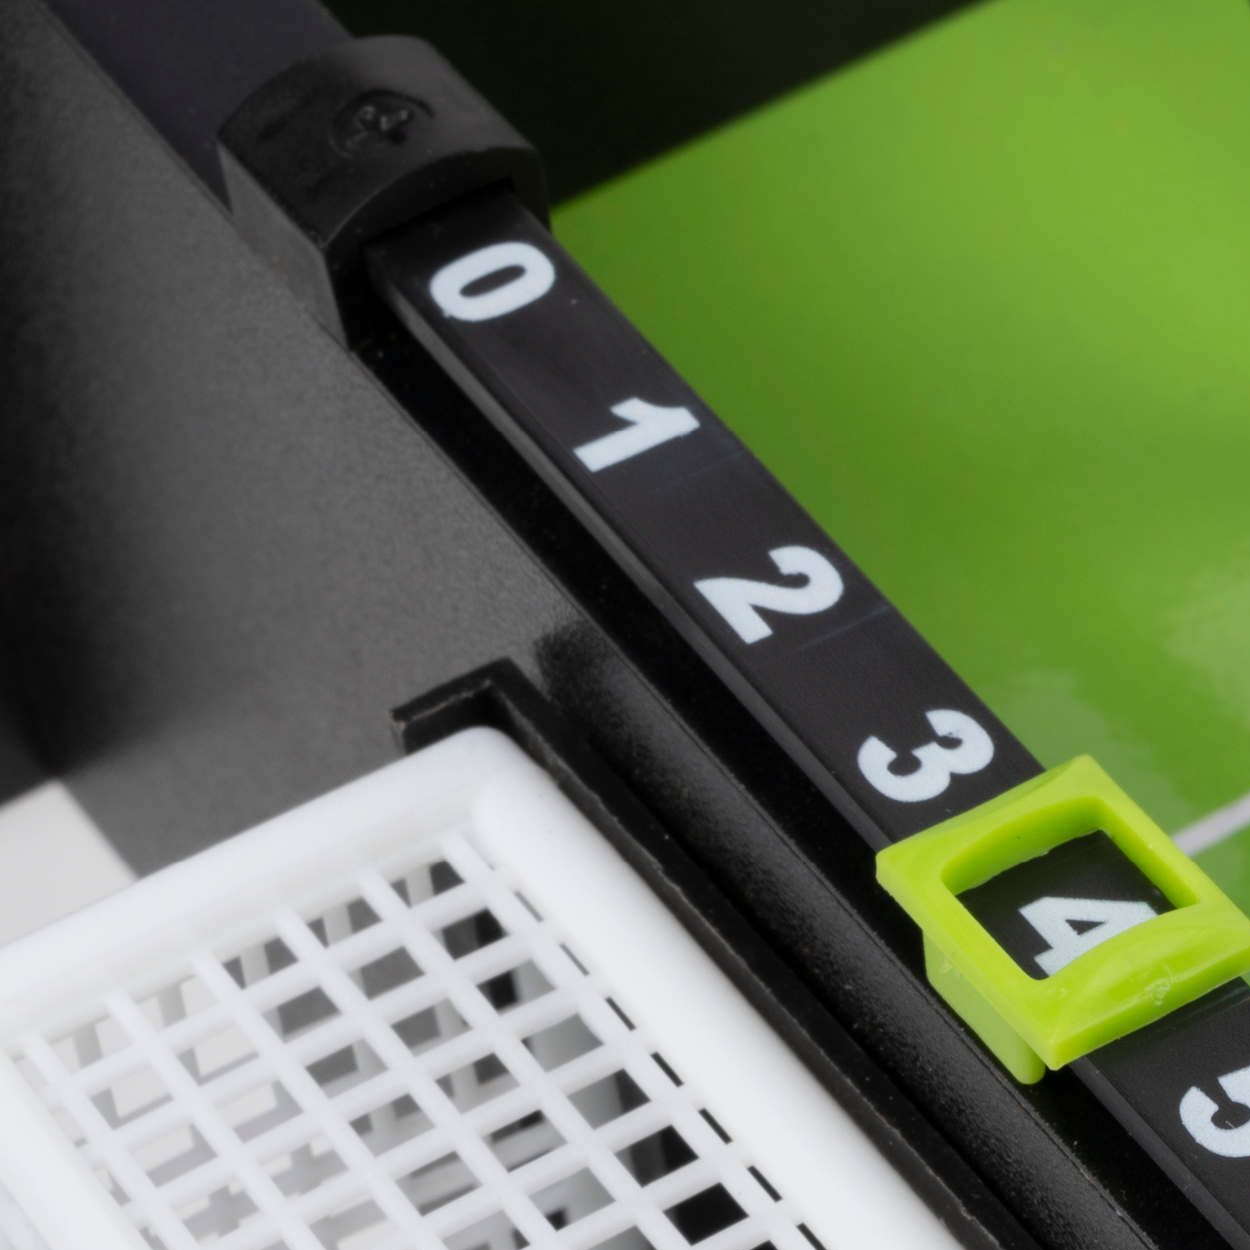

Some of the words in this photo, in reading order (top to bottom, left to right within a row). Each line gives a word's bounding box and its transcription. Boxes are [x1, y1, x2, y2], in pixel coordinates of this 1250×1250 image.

[430, 243, 555, 321] 0
[574, 398, 699, 472] 1
[694, 546, 843, 644] 2
[858, 710, 995, 802] 3
[1019, 896, 1160, 977] 4
